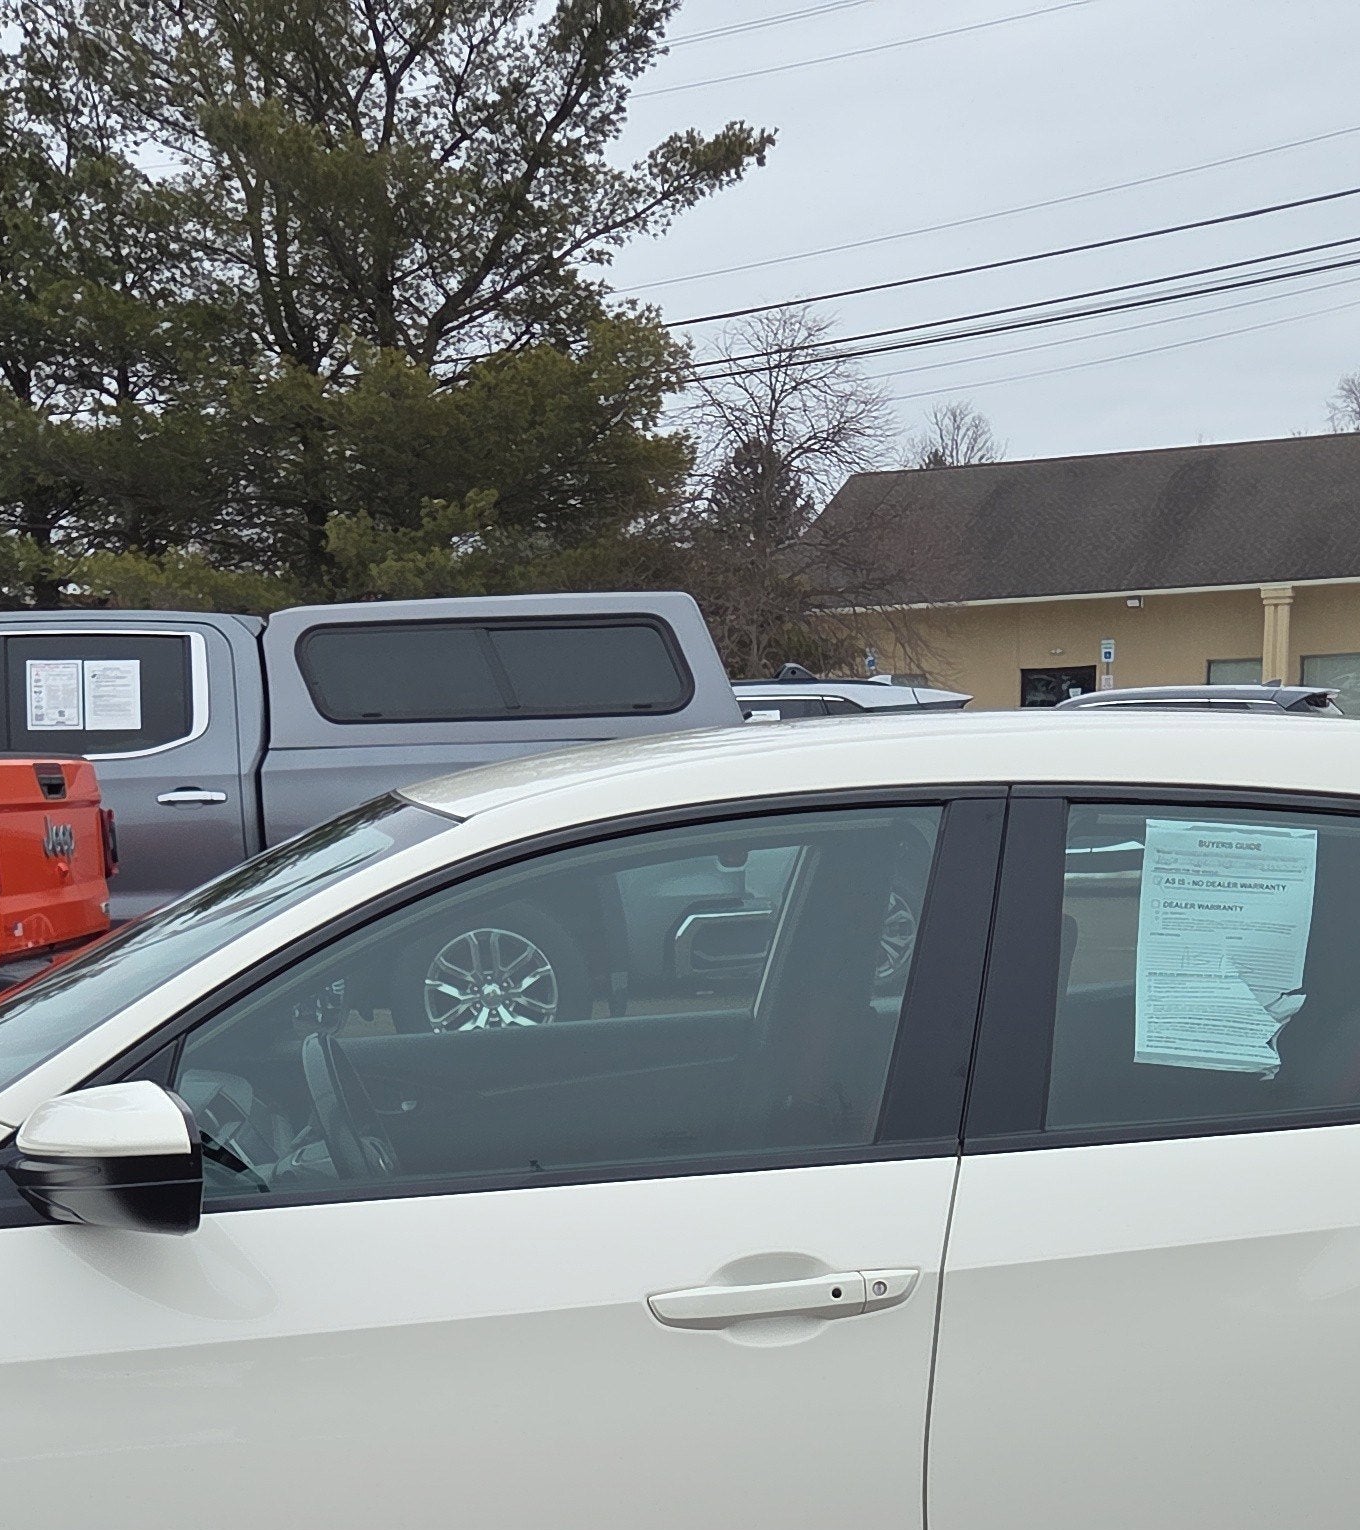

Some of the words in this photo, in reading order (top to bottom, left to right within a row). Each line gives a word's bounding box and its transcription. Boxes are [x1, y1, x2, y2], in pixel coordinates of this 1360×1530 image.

[1235, 842, 1262, 851] GUIDE
[1164, 877, 1176, 885] AS
[1178, 878, 1186, 886] IS
[1192, 879, 1204, 887] NO
[1206, 880, 1238, 889] DEALER
[1240, 882, 1287, 892] WARRANTY
[1163, 900, 1196, 910] DEALER
[1198, 903, 1244, 912] WARRANTY
